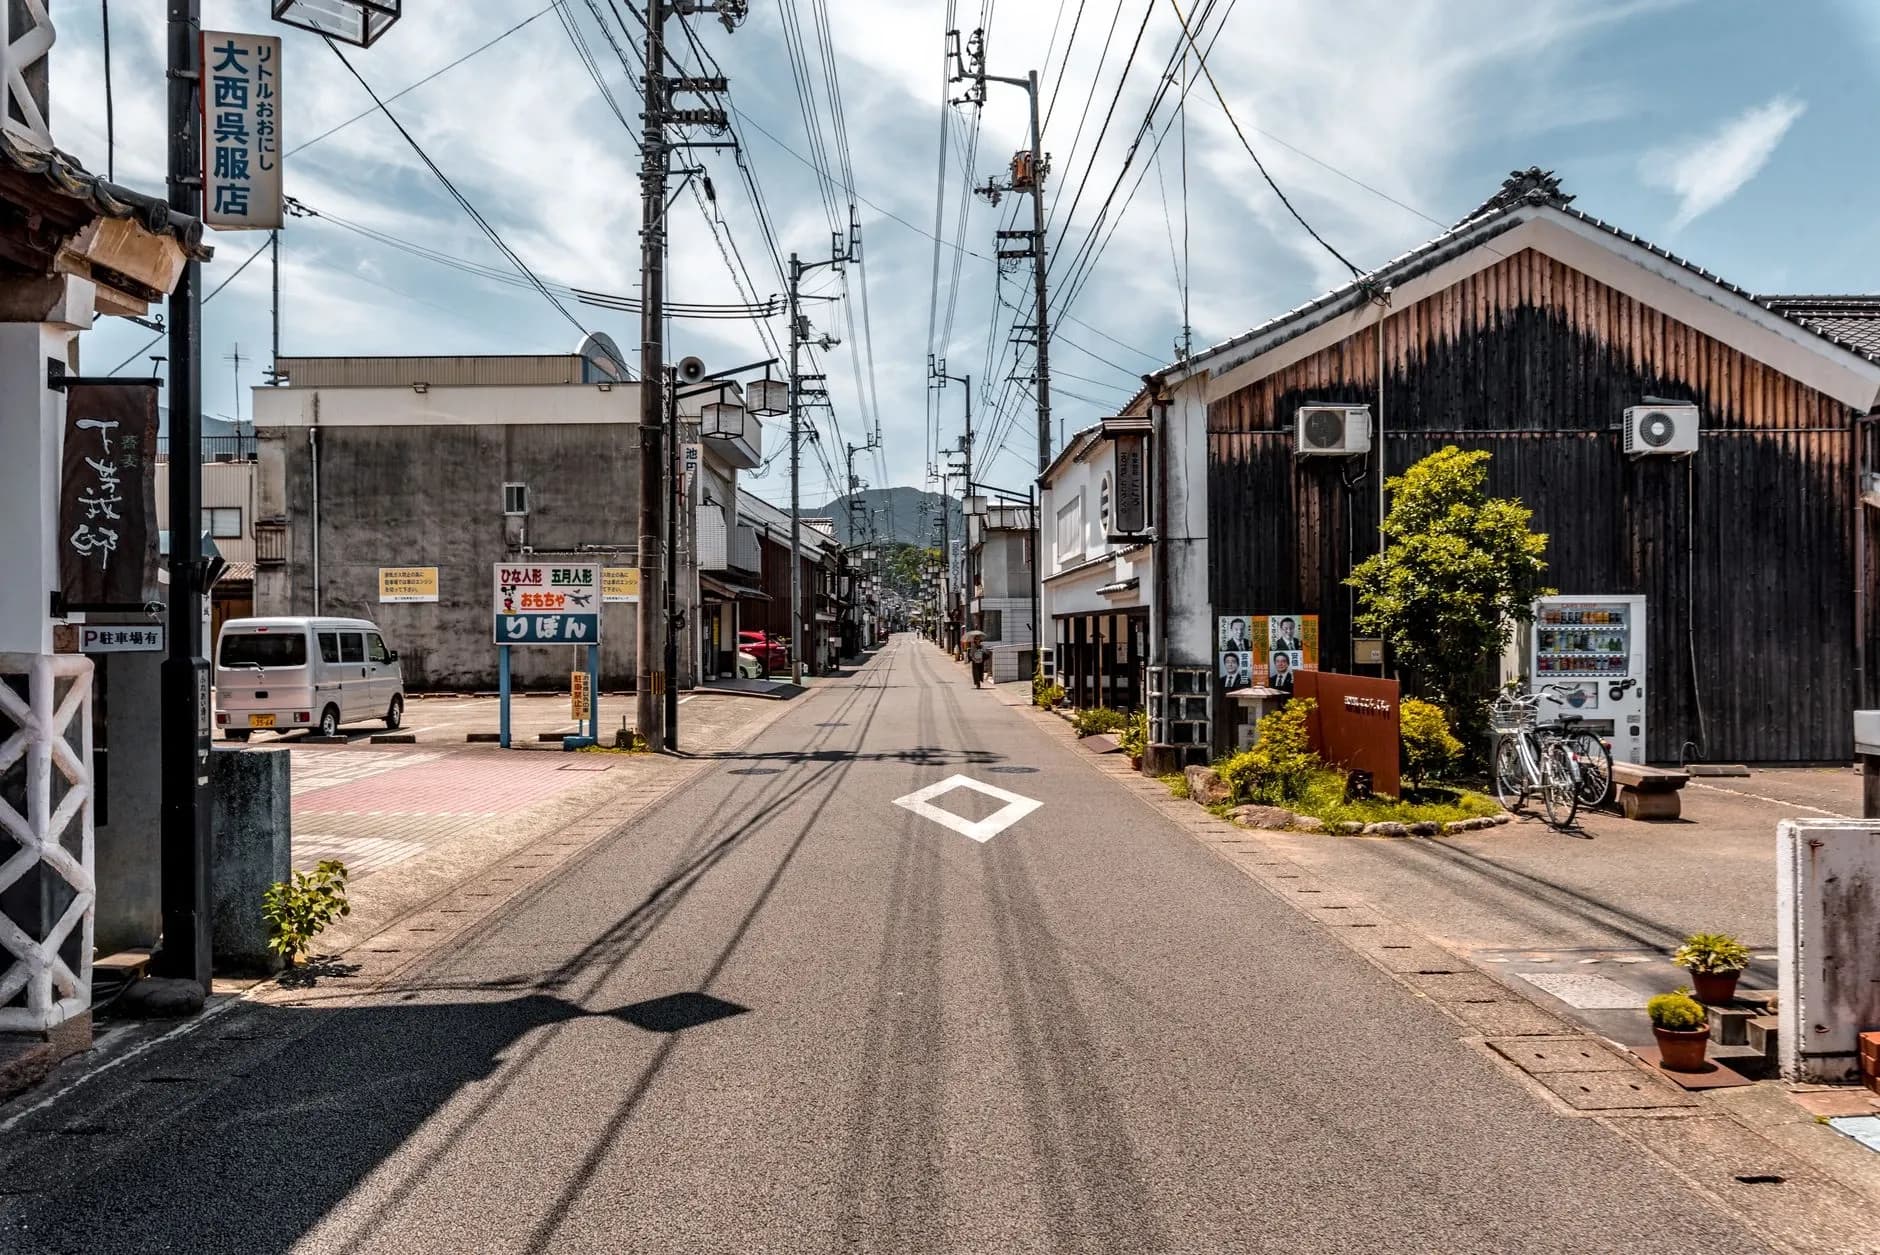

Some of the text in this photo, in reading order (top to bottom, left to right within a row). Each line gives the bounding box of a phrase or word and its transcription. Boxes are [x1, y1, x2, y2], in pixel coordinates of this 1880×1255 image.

[256, 46, 274, 170] リトルおおにし
[213, 40, 250, 216] 大西呉服店
[501, 568, 542, 584] ひな人形
[551, 568, 593, 584] 五月人形
[521, 592, 565, 607] おもちゃ
[506, 615, 587, 639] りぼん
